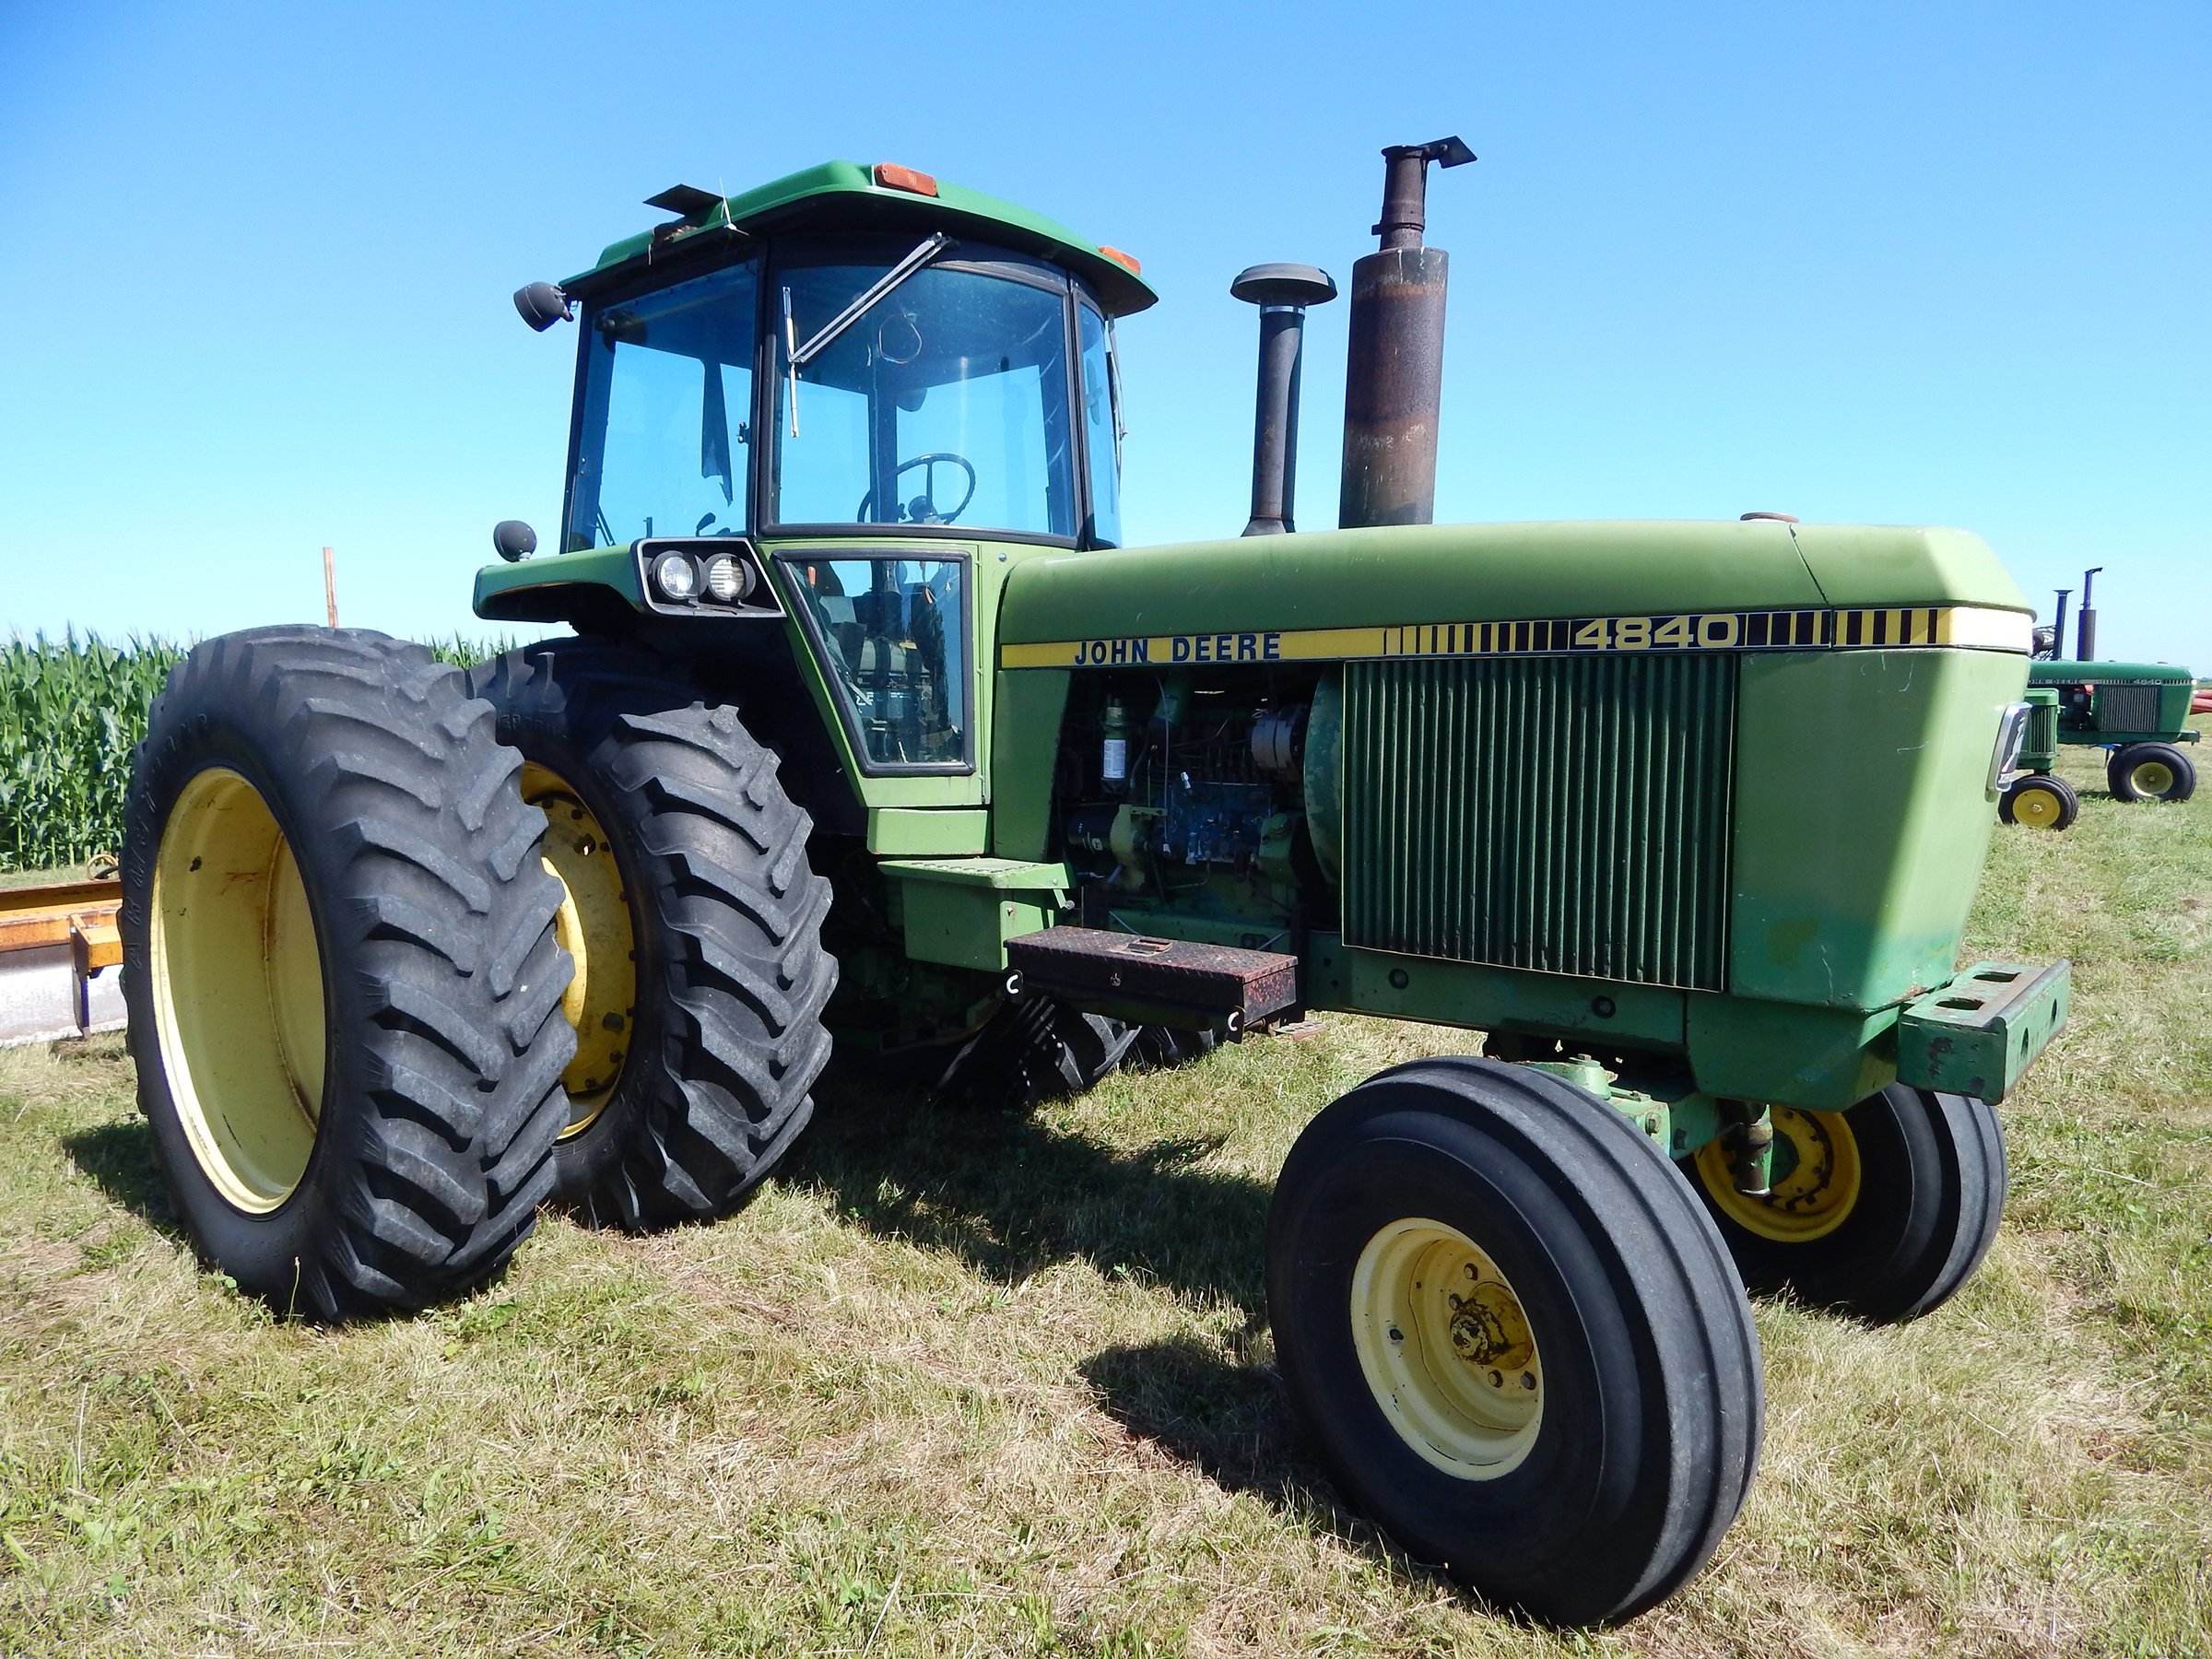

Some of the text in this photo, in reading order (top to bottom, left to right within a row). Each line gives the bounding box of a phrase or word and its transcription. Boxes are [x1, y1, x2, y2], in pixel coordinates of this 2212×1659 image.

[1075, 632, 1281, 665] JOHN DEERE
[1574, 613, 1739, 651] 4840
